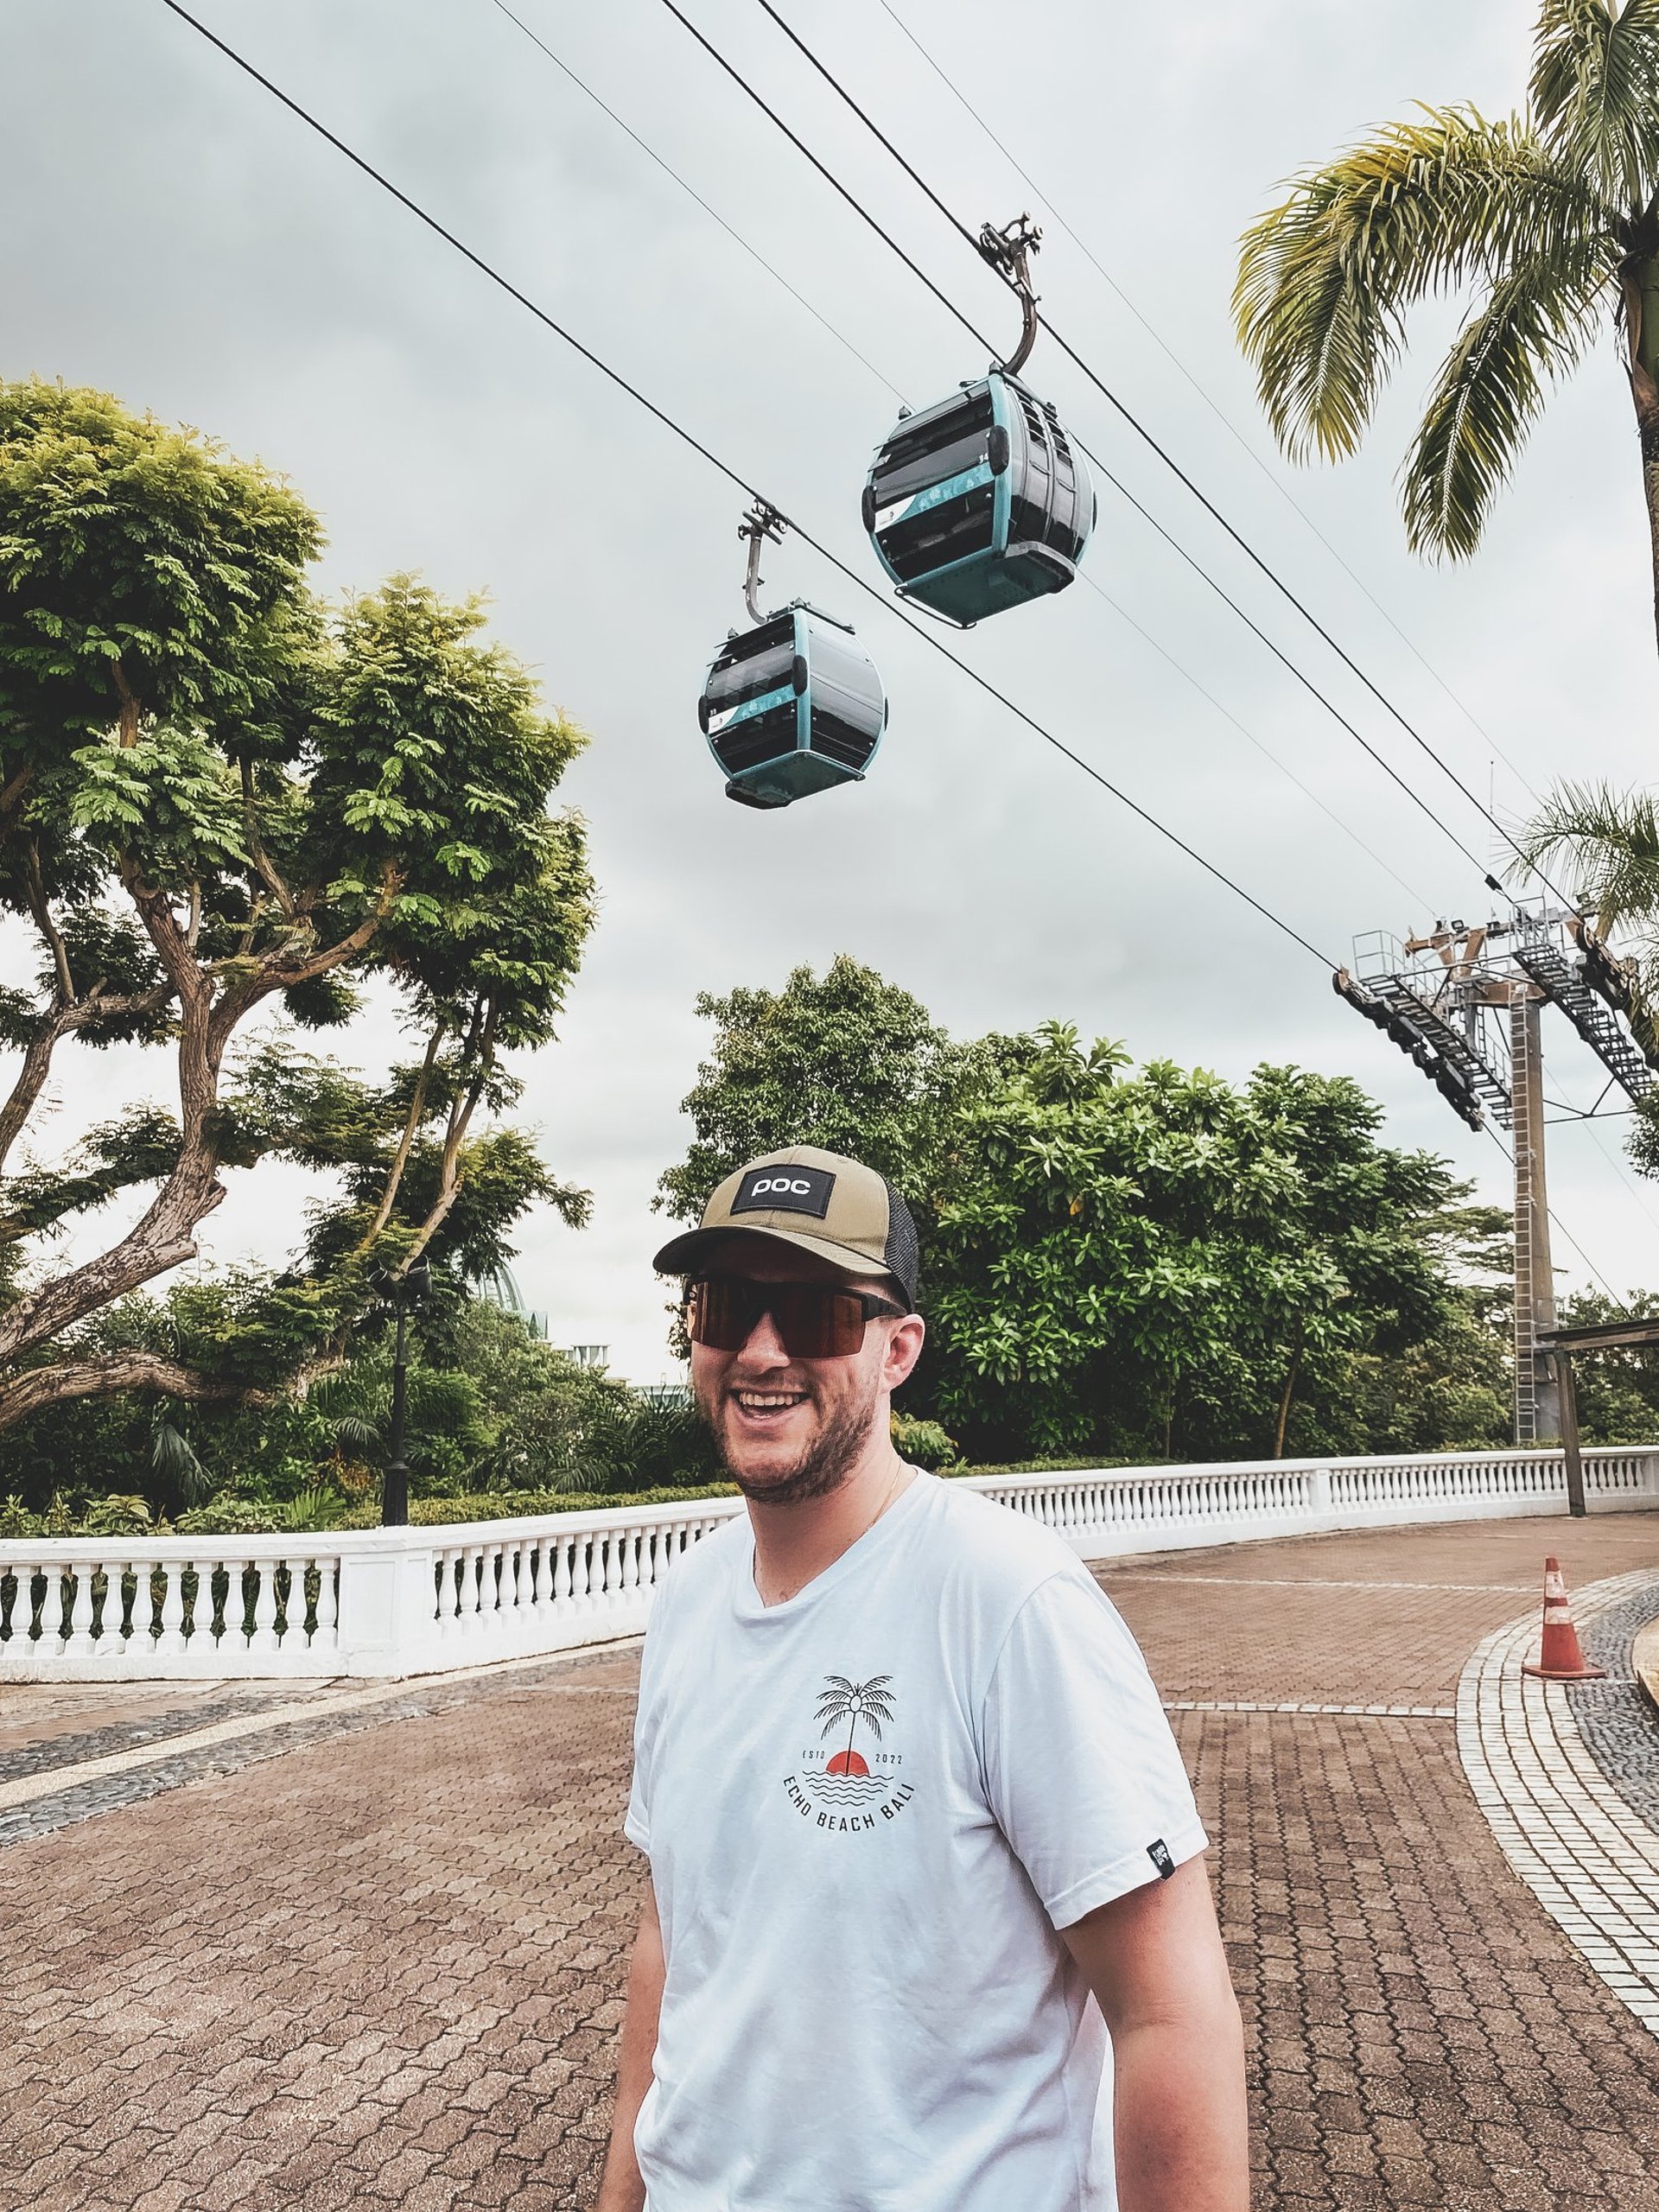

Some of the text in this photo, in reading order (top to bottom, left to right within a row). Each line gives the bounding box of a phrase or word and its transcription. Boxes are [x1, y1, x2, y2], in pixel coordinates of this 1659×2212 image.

[875, 1753, 902, 1764] 2022
[783, 1776, 915, 1832] ECHO BEACH BALI
